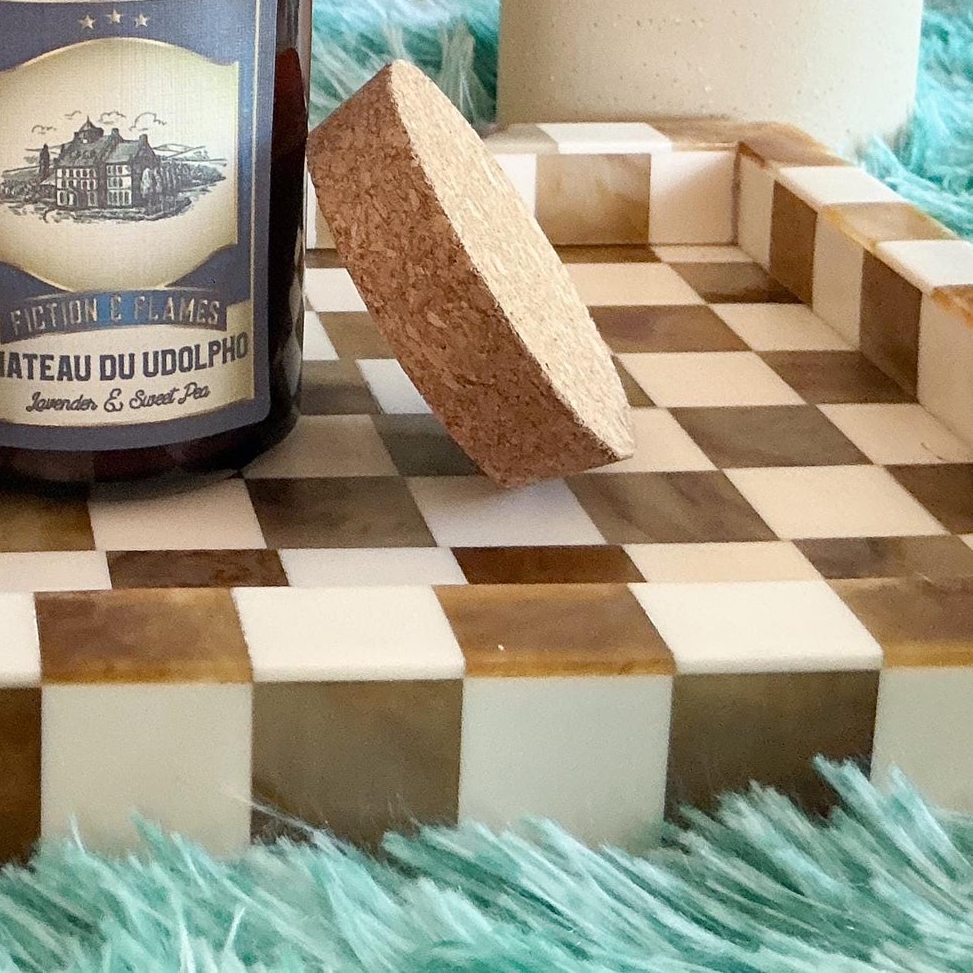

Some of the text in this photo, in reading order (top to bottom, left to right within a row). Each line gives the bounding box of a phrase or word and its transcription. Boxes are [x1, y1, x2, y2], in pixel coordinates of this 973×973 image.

[10, 299, 98, 336] FICTION
[134, 296, 221, 325] FLAMES
[99, 353, 135, 381] DU
[142, 331, 249, 378] UDOLPHO
[25, 381, 211, 413] Lavender & Sweet Pea
